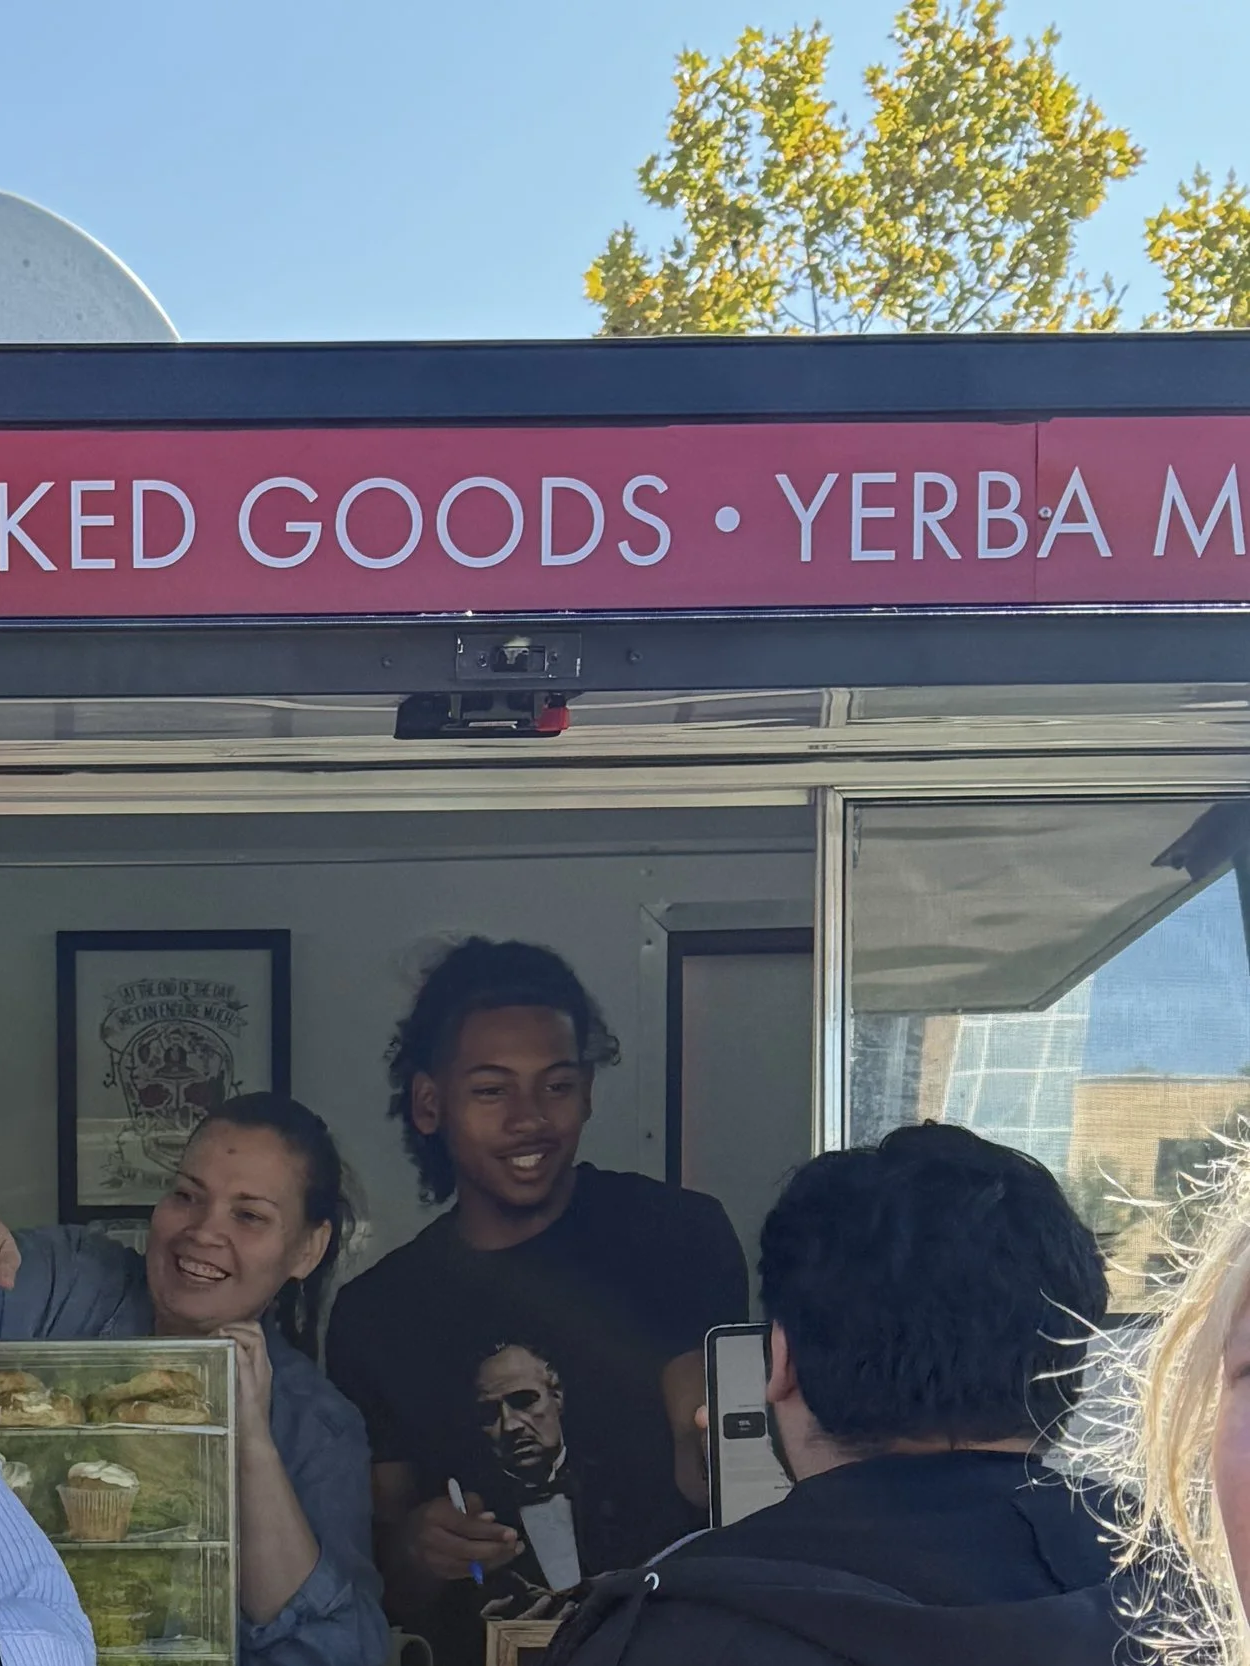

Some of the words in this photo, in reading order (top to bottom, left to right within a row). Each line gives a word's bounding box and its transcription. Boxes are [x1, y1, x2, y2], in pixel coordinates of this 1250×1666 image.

[239, 475, 670, 569] GOODS
[775, 467, 1113, 562] YERBA
[1153, 463, 1246, 558] M
